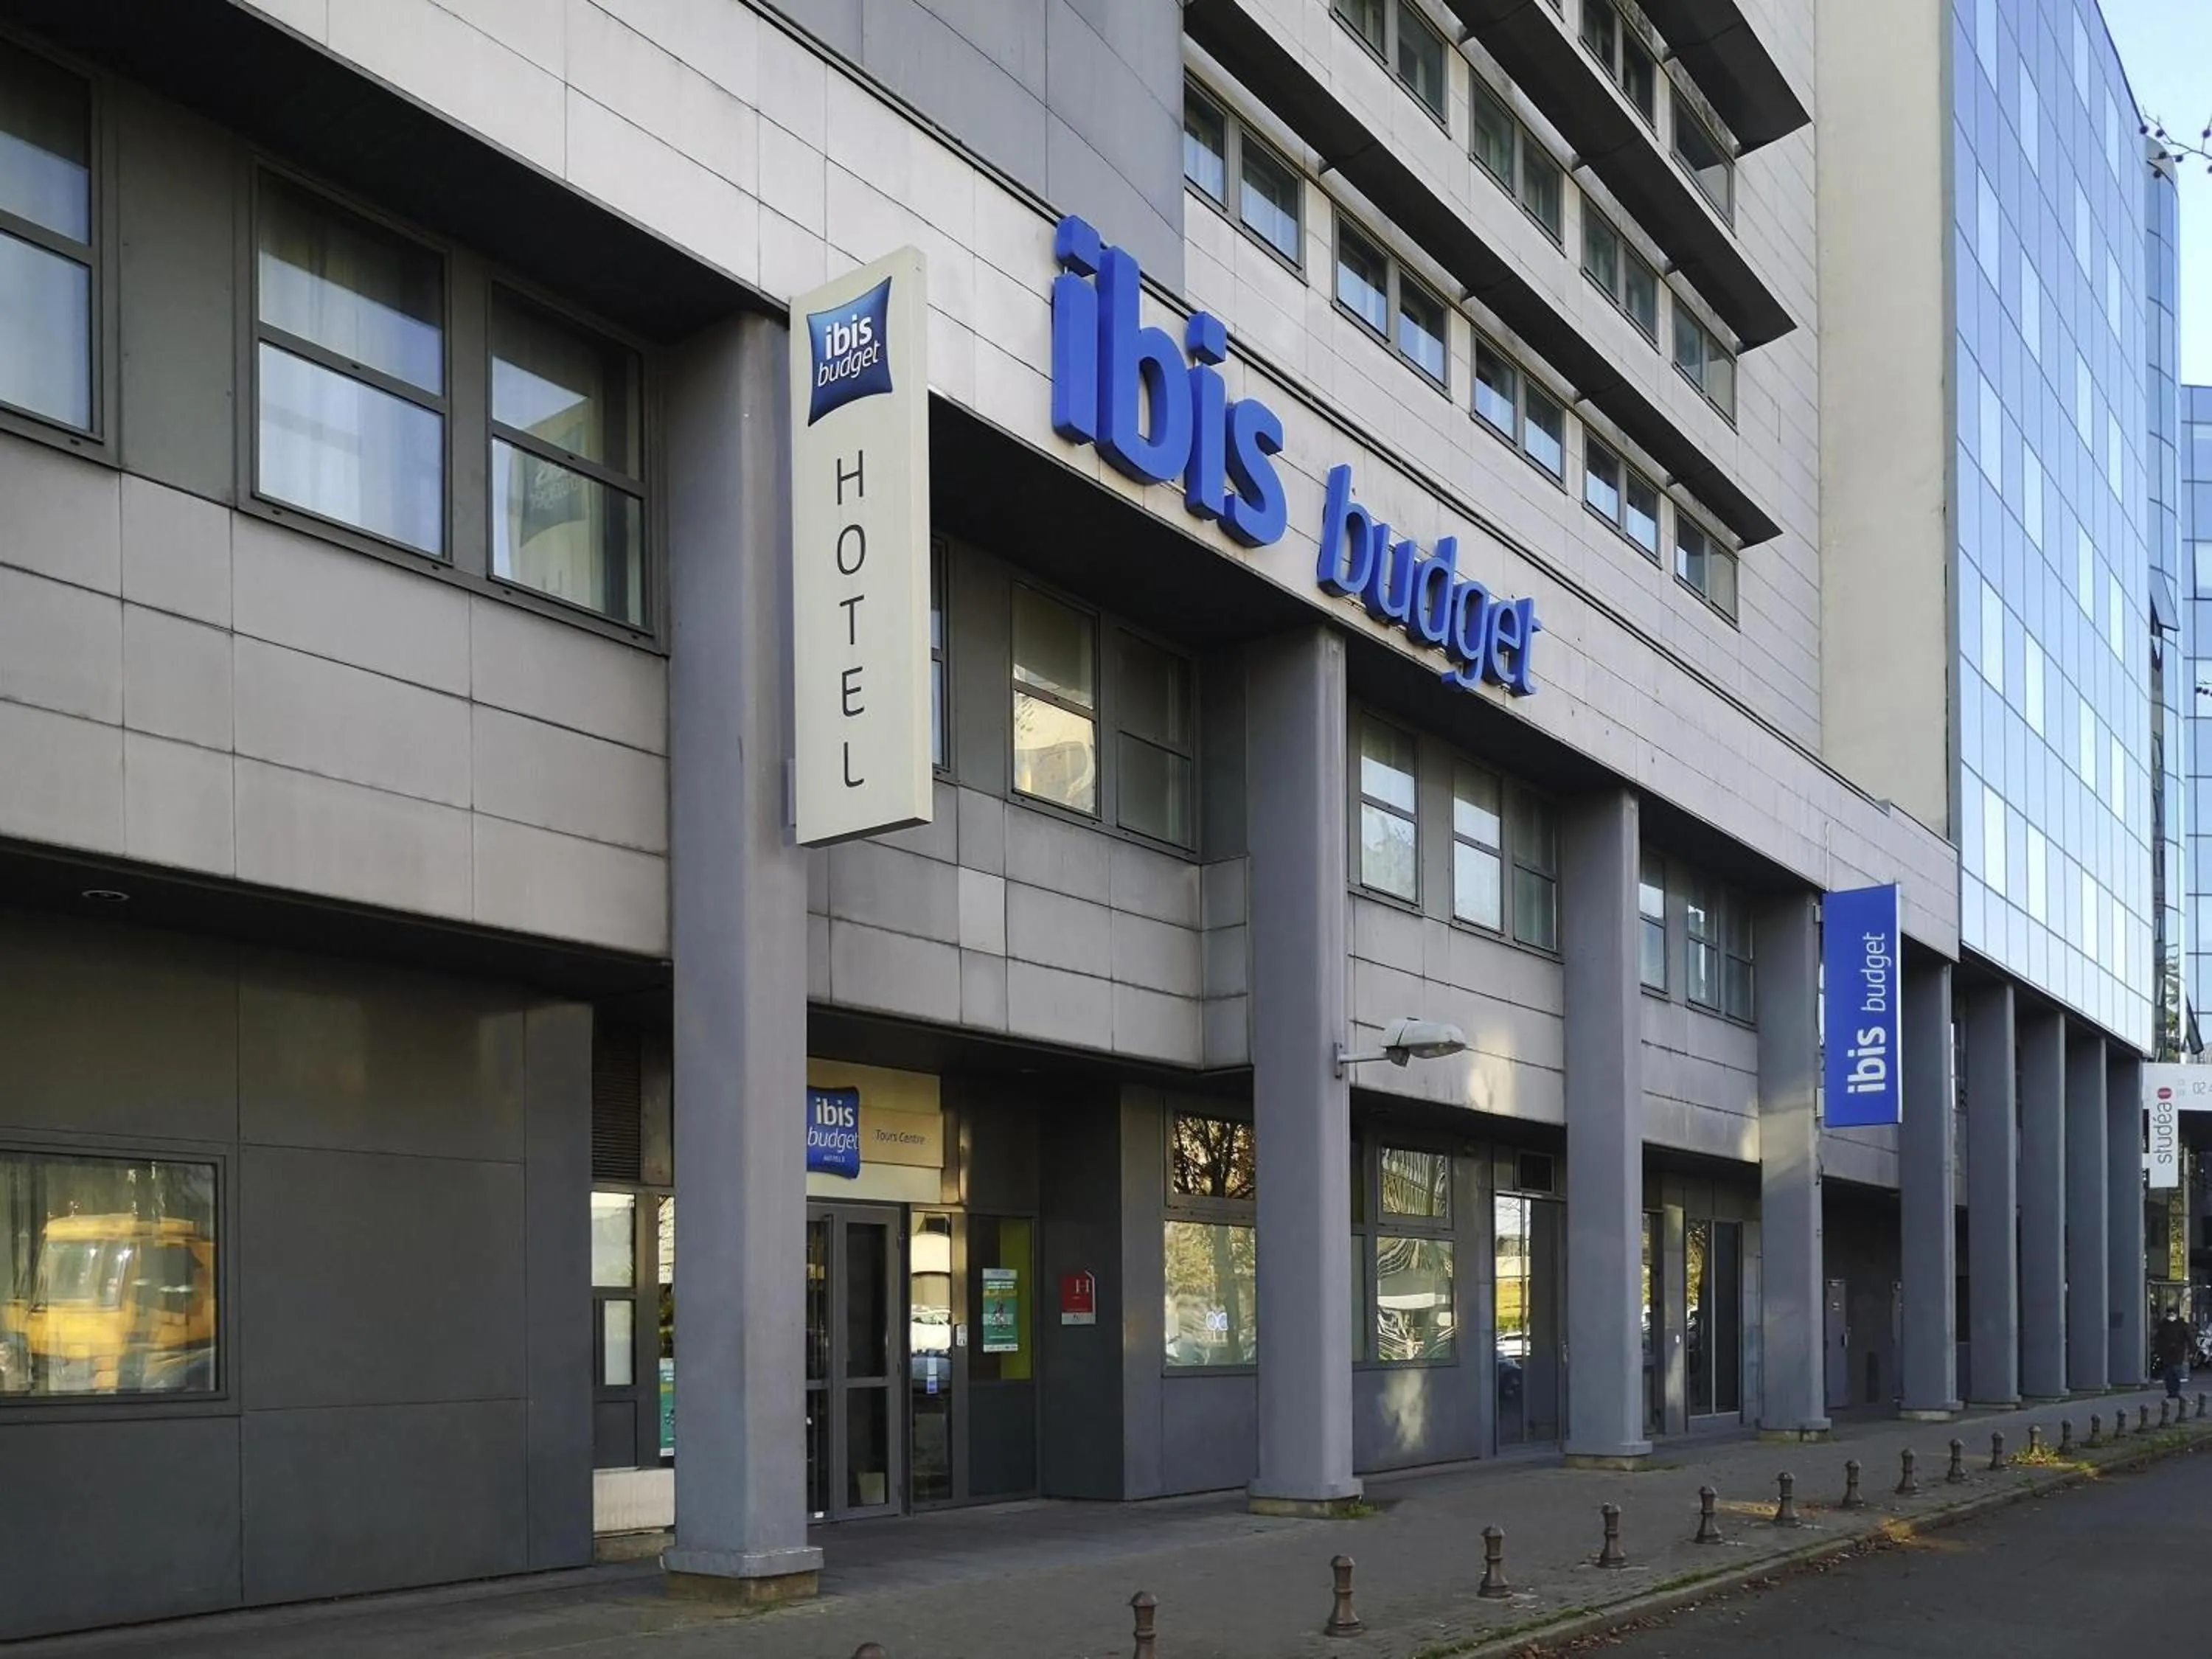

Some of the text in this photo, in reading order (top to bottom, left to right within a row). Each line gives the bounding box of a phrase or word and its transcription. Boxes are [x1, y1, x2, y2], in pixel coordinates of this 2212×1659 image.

[825, 313, 872, 360] ibis
[818, 340, 881, 387] budget
[1051, 215, 1542, 696] ibis budget
[836, 449, 865, 789] HOTEL
[1847, 931, 1891, 1093] ibis budget
[815, 1096, 854, 1127] ibis
[2153, 1102, 2173, 1164] studéa
[807, 1127, 859, 1154] budget
[875, 1130, 897, 1142] Tours
